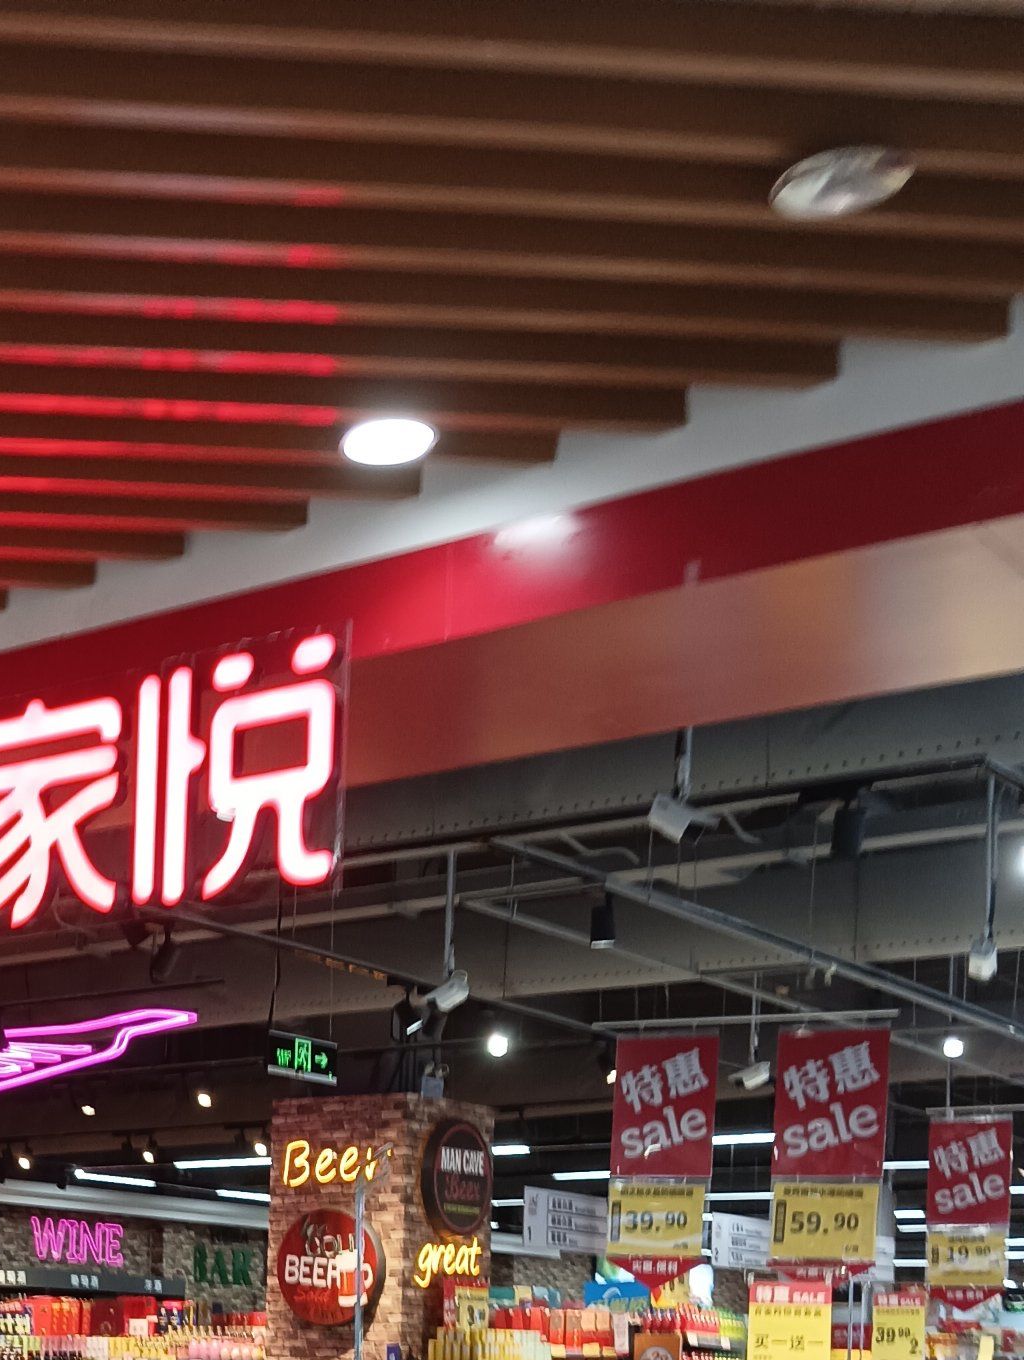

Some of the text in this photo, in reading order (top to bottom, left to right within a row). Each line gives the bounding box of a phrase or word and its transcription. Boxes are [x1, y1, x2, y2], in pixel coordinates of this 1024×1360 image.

[621, 1047, 709, 1113] 特惠
[783, 1041, 880, 1110] 特惠
[621, 1106, 707, 1158] sale
[783, 1102, 880, 1157] sale
[933, 1127, 1005, 1180] 特惠
[934, 1172, 1005, 1215] sale
[30, 1215, 124, 1268] WINE
[625, 1209, 689, 1233] 39.90
[790, 1210, 860, 1236] 59.90
[414, 1237, 482, 1288] great
[754, 1333, 824, 1351] 买一送一
